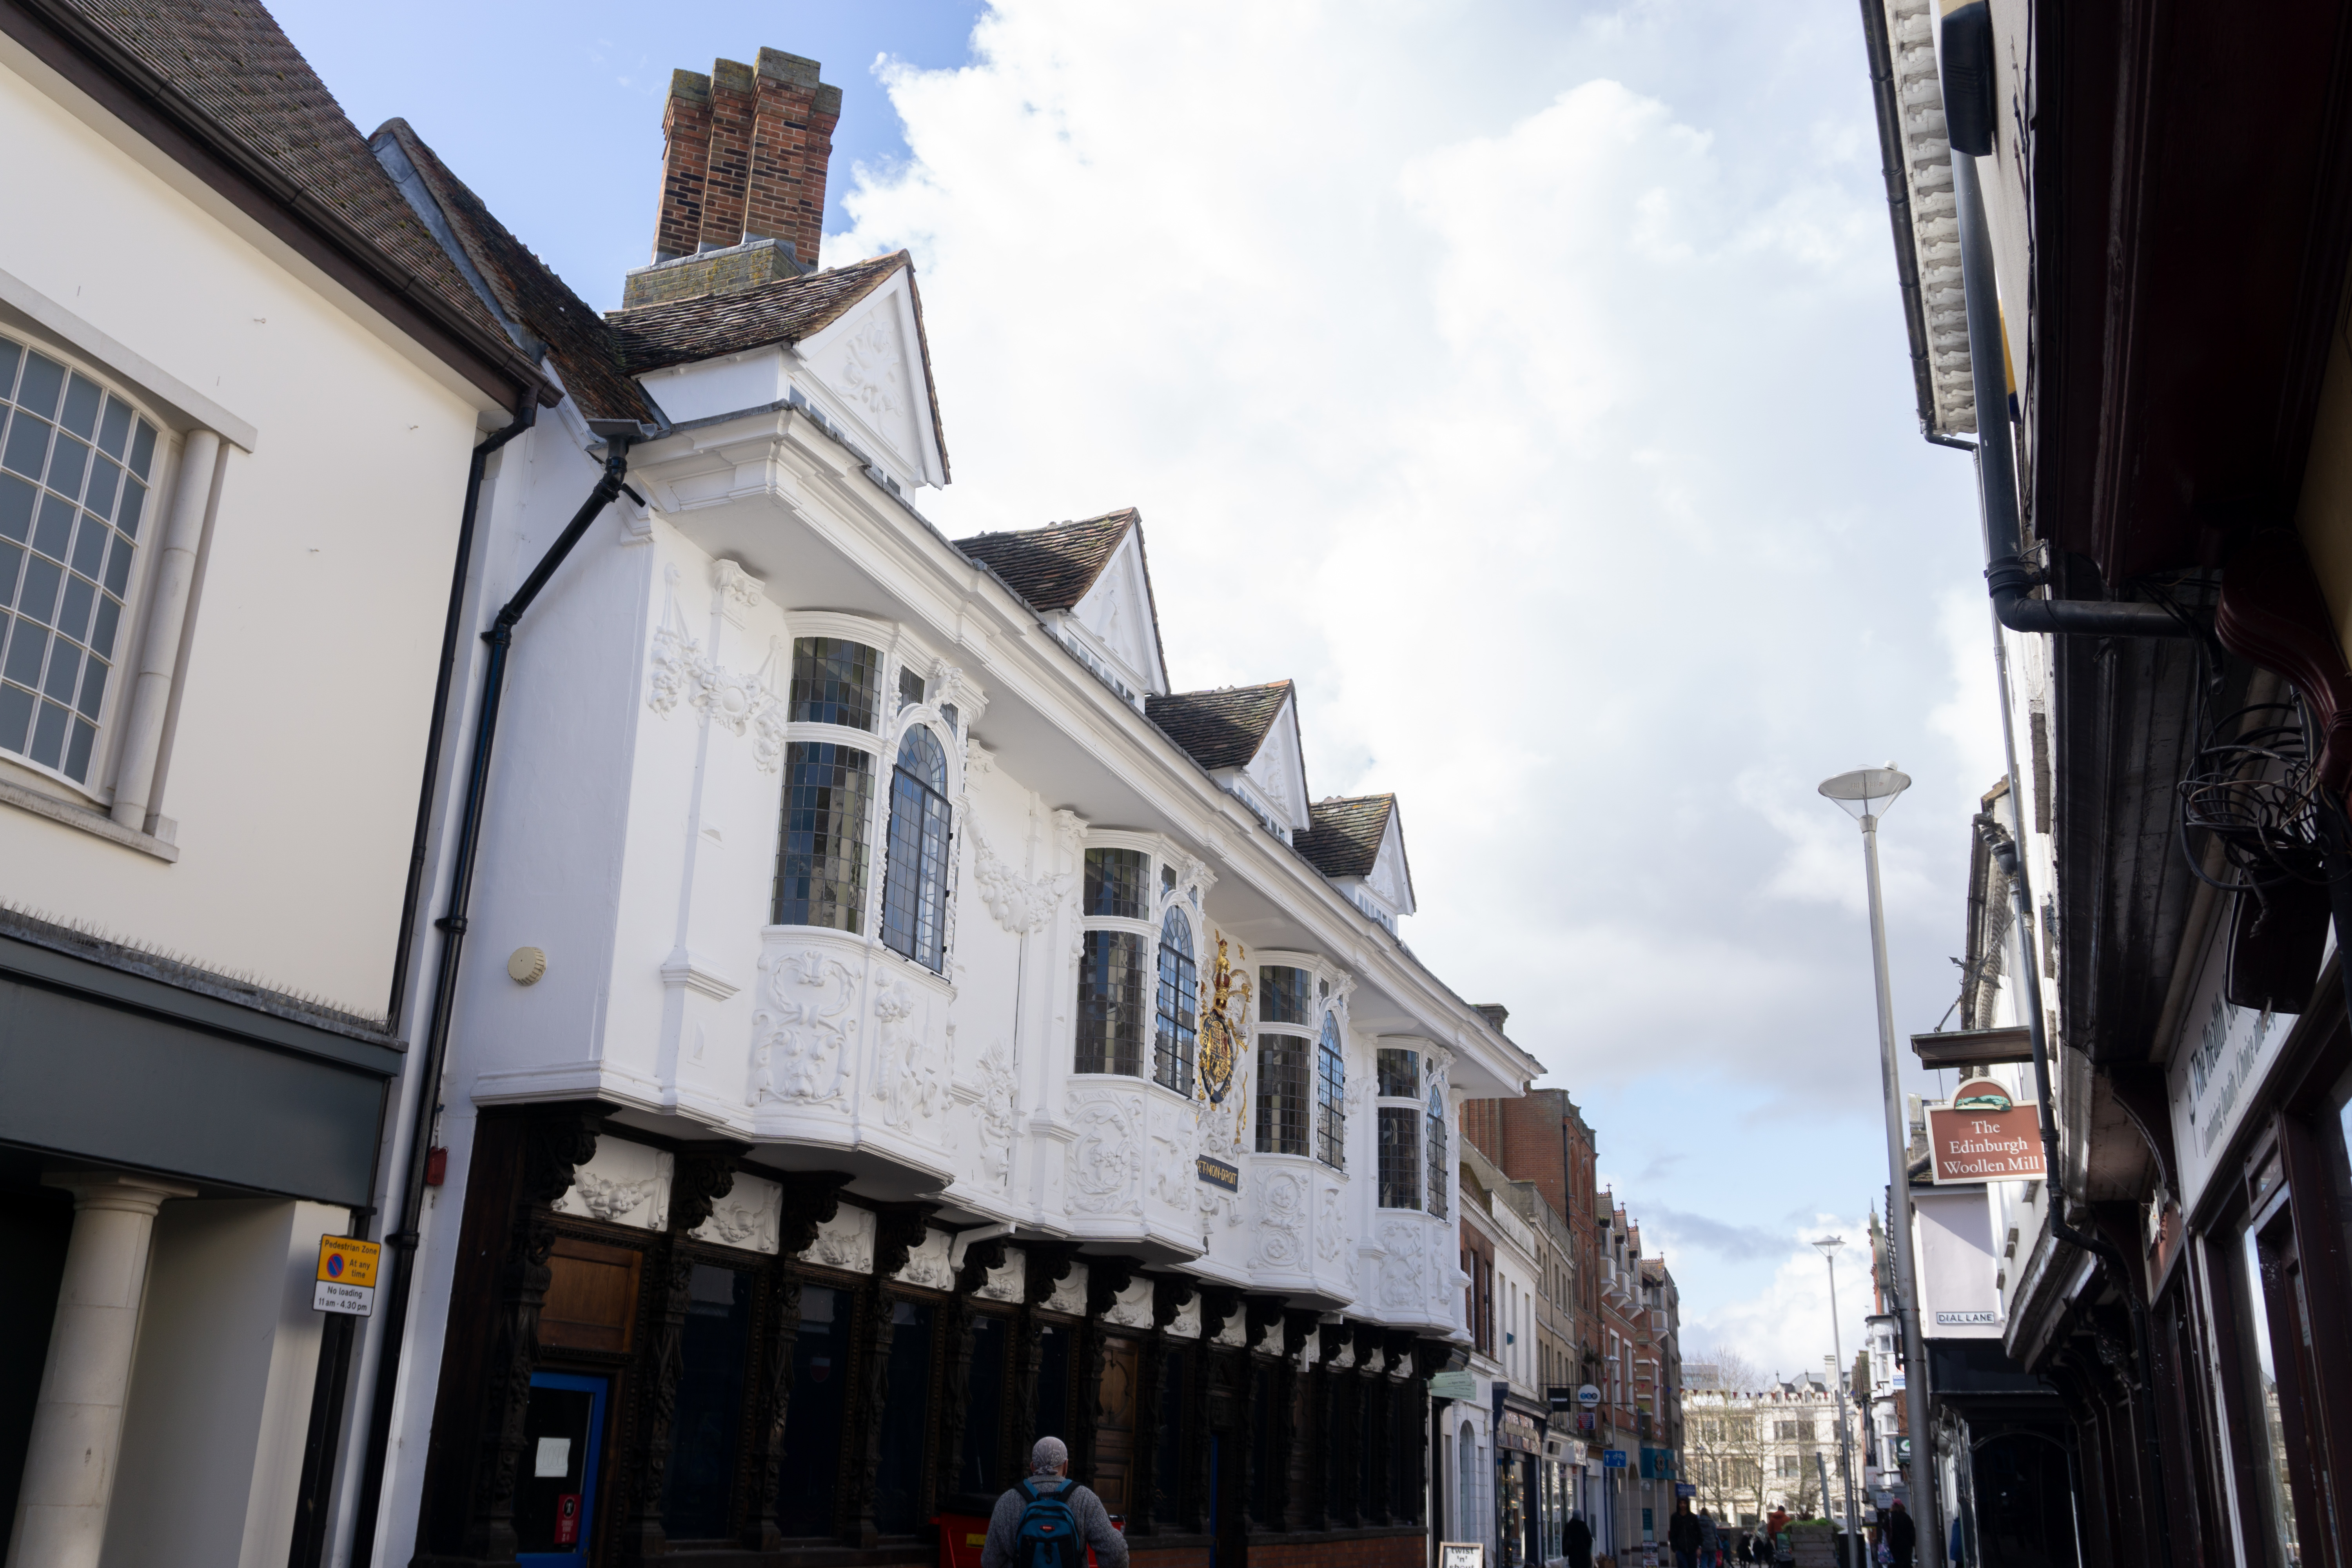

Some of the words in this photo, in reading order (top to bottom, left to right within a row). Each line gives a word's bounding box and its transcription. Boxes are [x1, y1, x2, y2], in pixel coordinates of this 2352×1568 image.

[2191, 1048, 2207, 1102] The
[2203, 992, 2227, 1079] Health
[2236, 1035, 2254, 1089] Choice
[1972, 1120, 2001, 1134] The
[1949, 1136, 2029, 1154] Edinburgh
[1944, 1159, 2005, 1174] Woollen
[2008, 1156, 2040, 1171] Mill
[325, 1240, 359, 1252] Pedestrian
[361, 1246, 377, 1255] Zone
[351, 1270, 365, 1279] time
[327, 1286, 337, 1294] No
[339, 1287, 362, 1299] loading
[340, 1300, 356, 1310] 4.30
